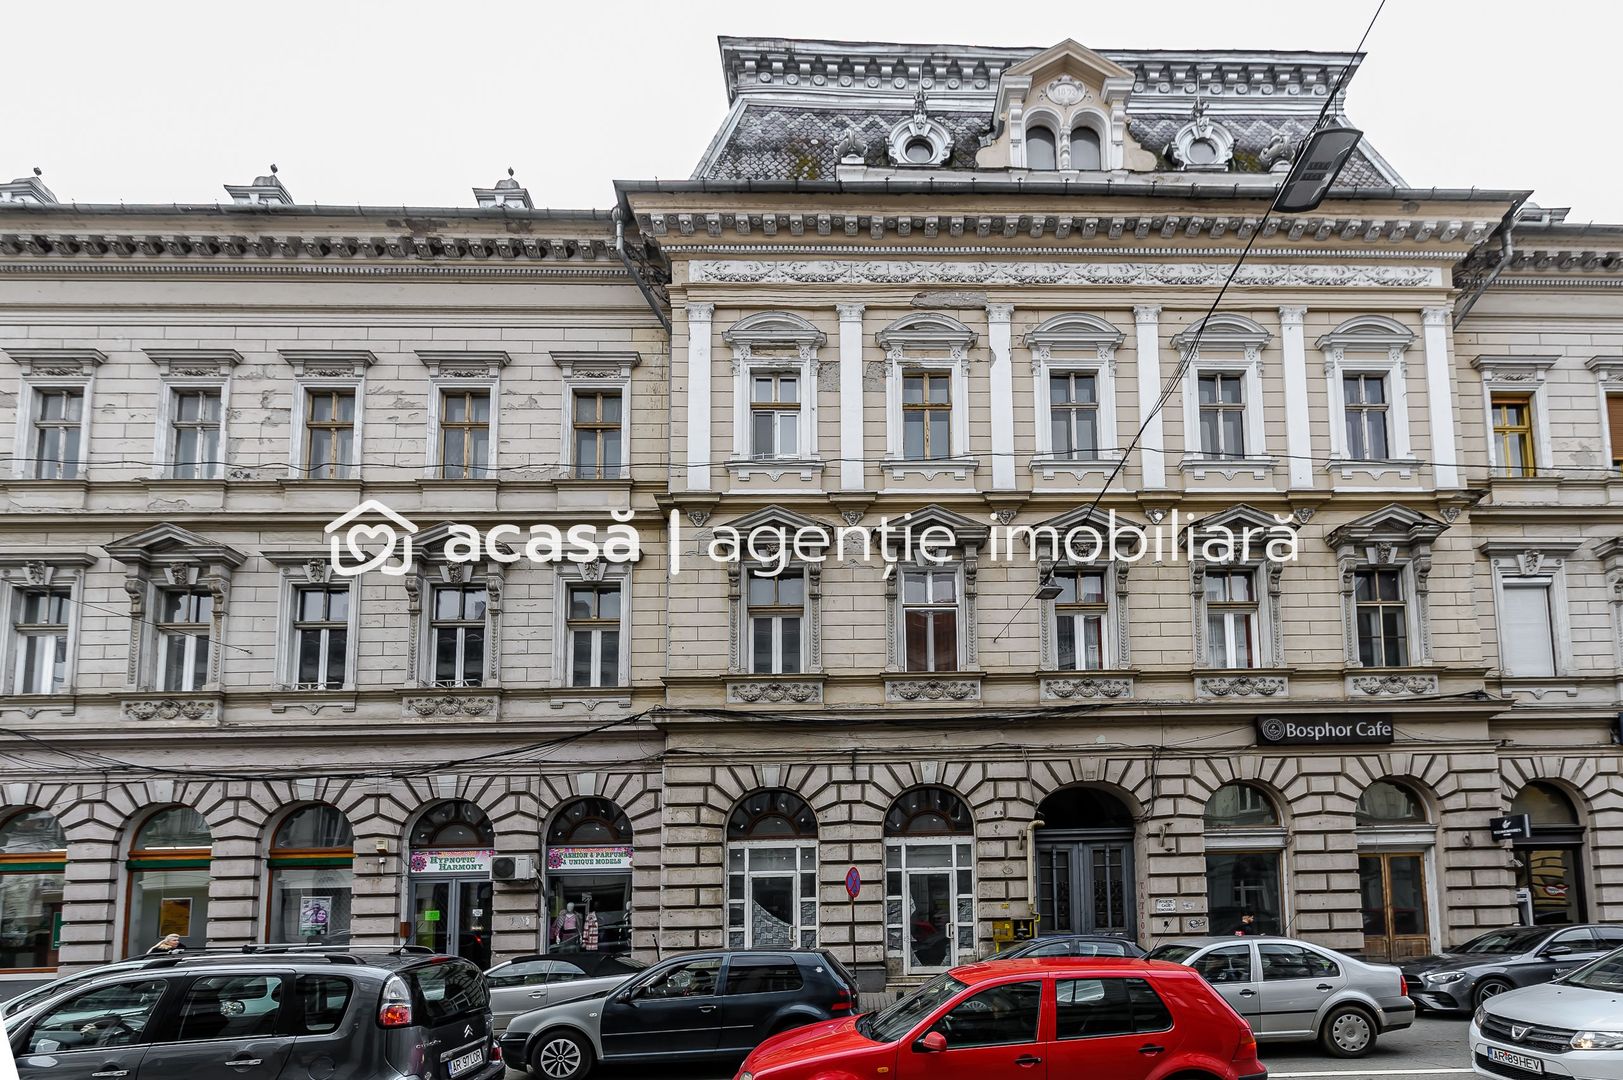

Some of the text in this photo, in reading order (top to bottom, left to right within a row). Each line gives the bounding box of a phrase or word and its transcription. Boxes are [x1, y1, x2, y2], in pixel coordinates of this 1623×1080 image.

[1286, 721, 1391, 740] Bosphor Cafe
[430, 856, 476, 864] HYPNOTIC
[439, 863, 484, 871] HARMONY
[452, 1059, 461, 1072] AR
[1494, 1050, 1540, 1070] AR 89 HEV
